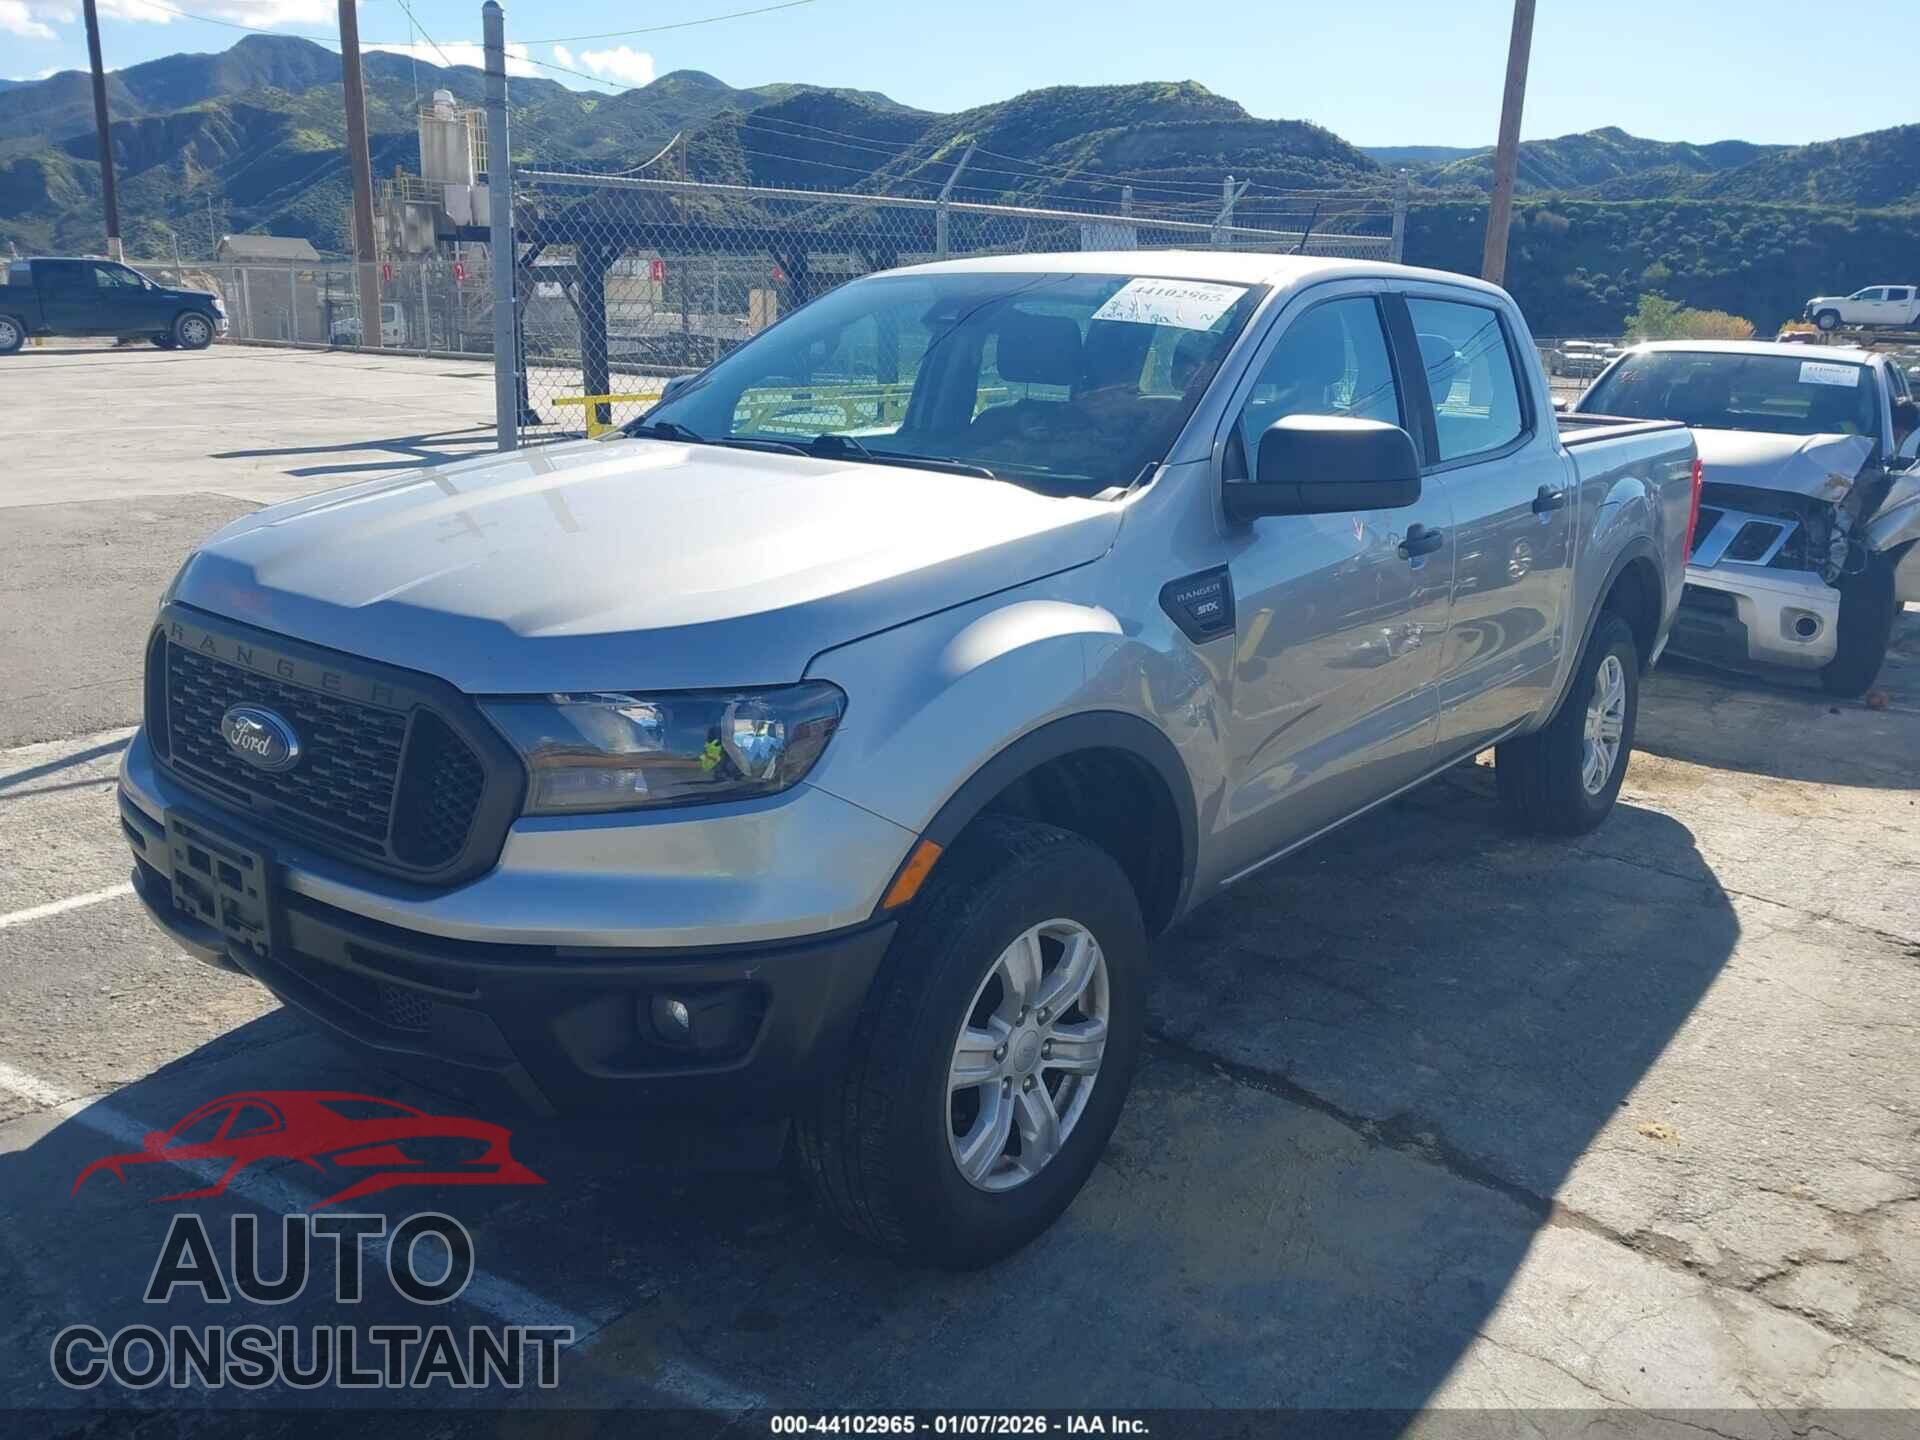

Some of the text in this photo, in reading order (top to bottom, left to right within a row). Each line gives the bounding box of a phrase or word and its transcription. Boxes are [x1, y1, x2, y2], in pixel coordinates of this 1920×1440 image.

[1176, 583, 1220, 602] RANGER
[1197, 601, 1219, 616] STX
[170, 621, 393, 704] RANGER
[231, 716, 270, 757] Ford
